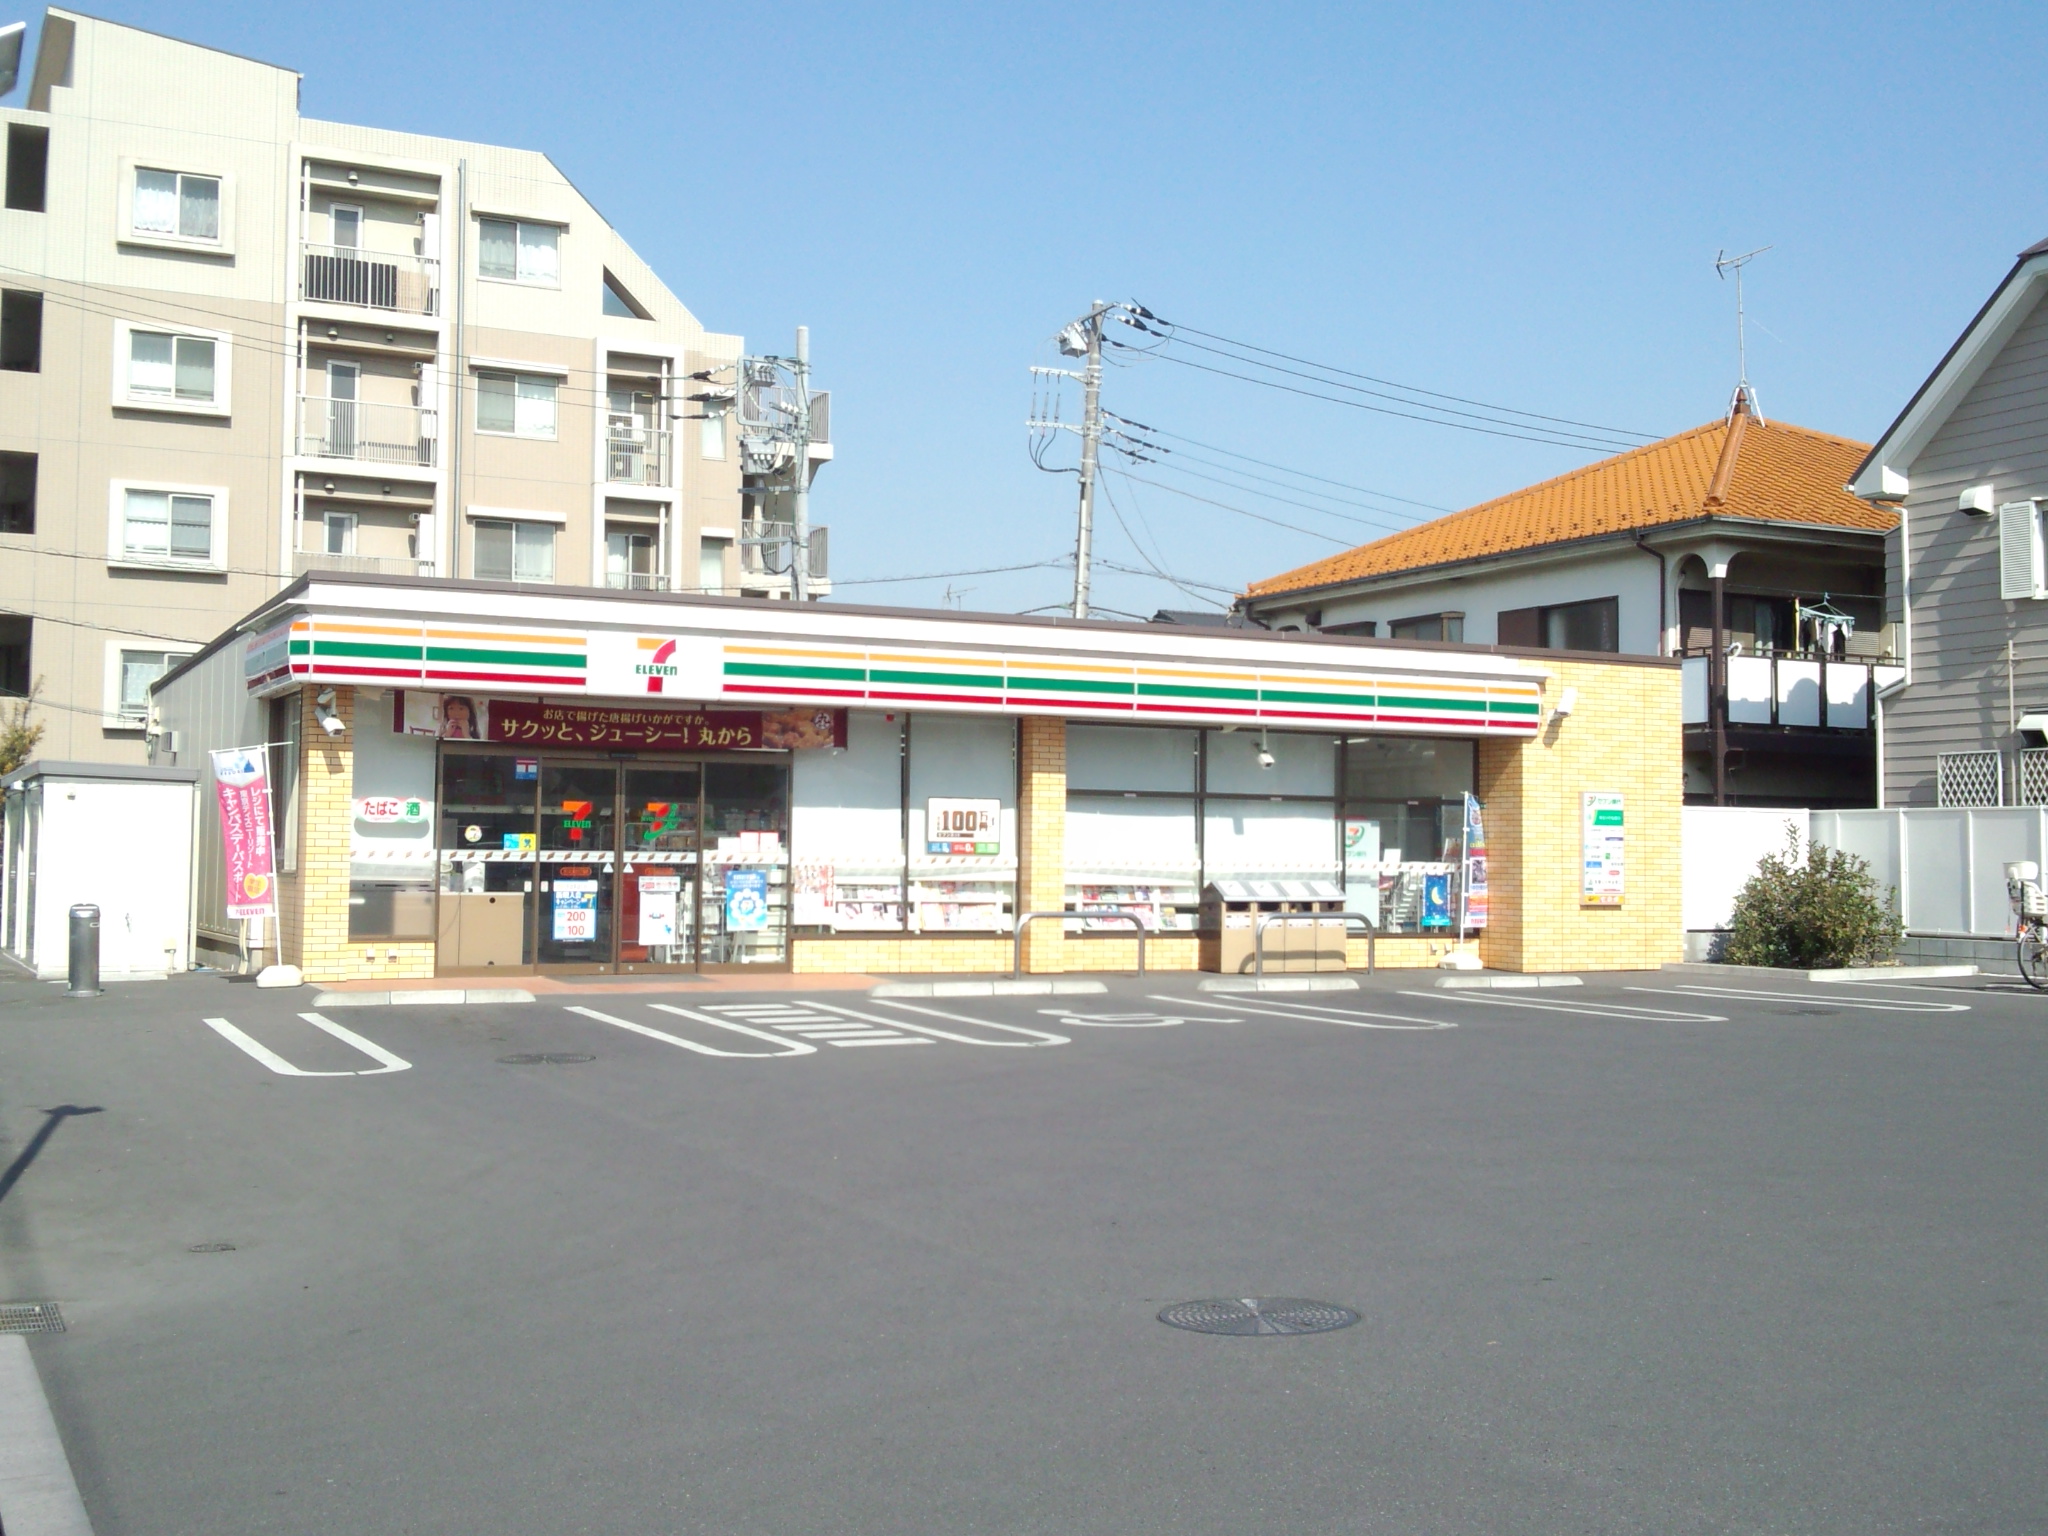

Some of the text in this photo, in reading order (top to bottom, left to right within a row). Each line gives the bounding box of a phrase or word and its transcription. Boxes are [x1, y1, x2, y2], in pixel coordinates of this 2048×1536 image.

[364, 801, 399, 816] たばこ
[406, 801, 421, 816] 酒
[567, 911, 586, 922] 200
[567, 925, 585, 936] 100
